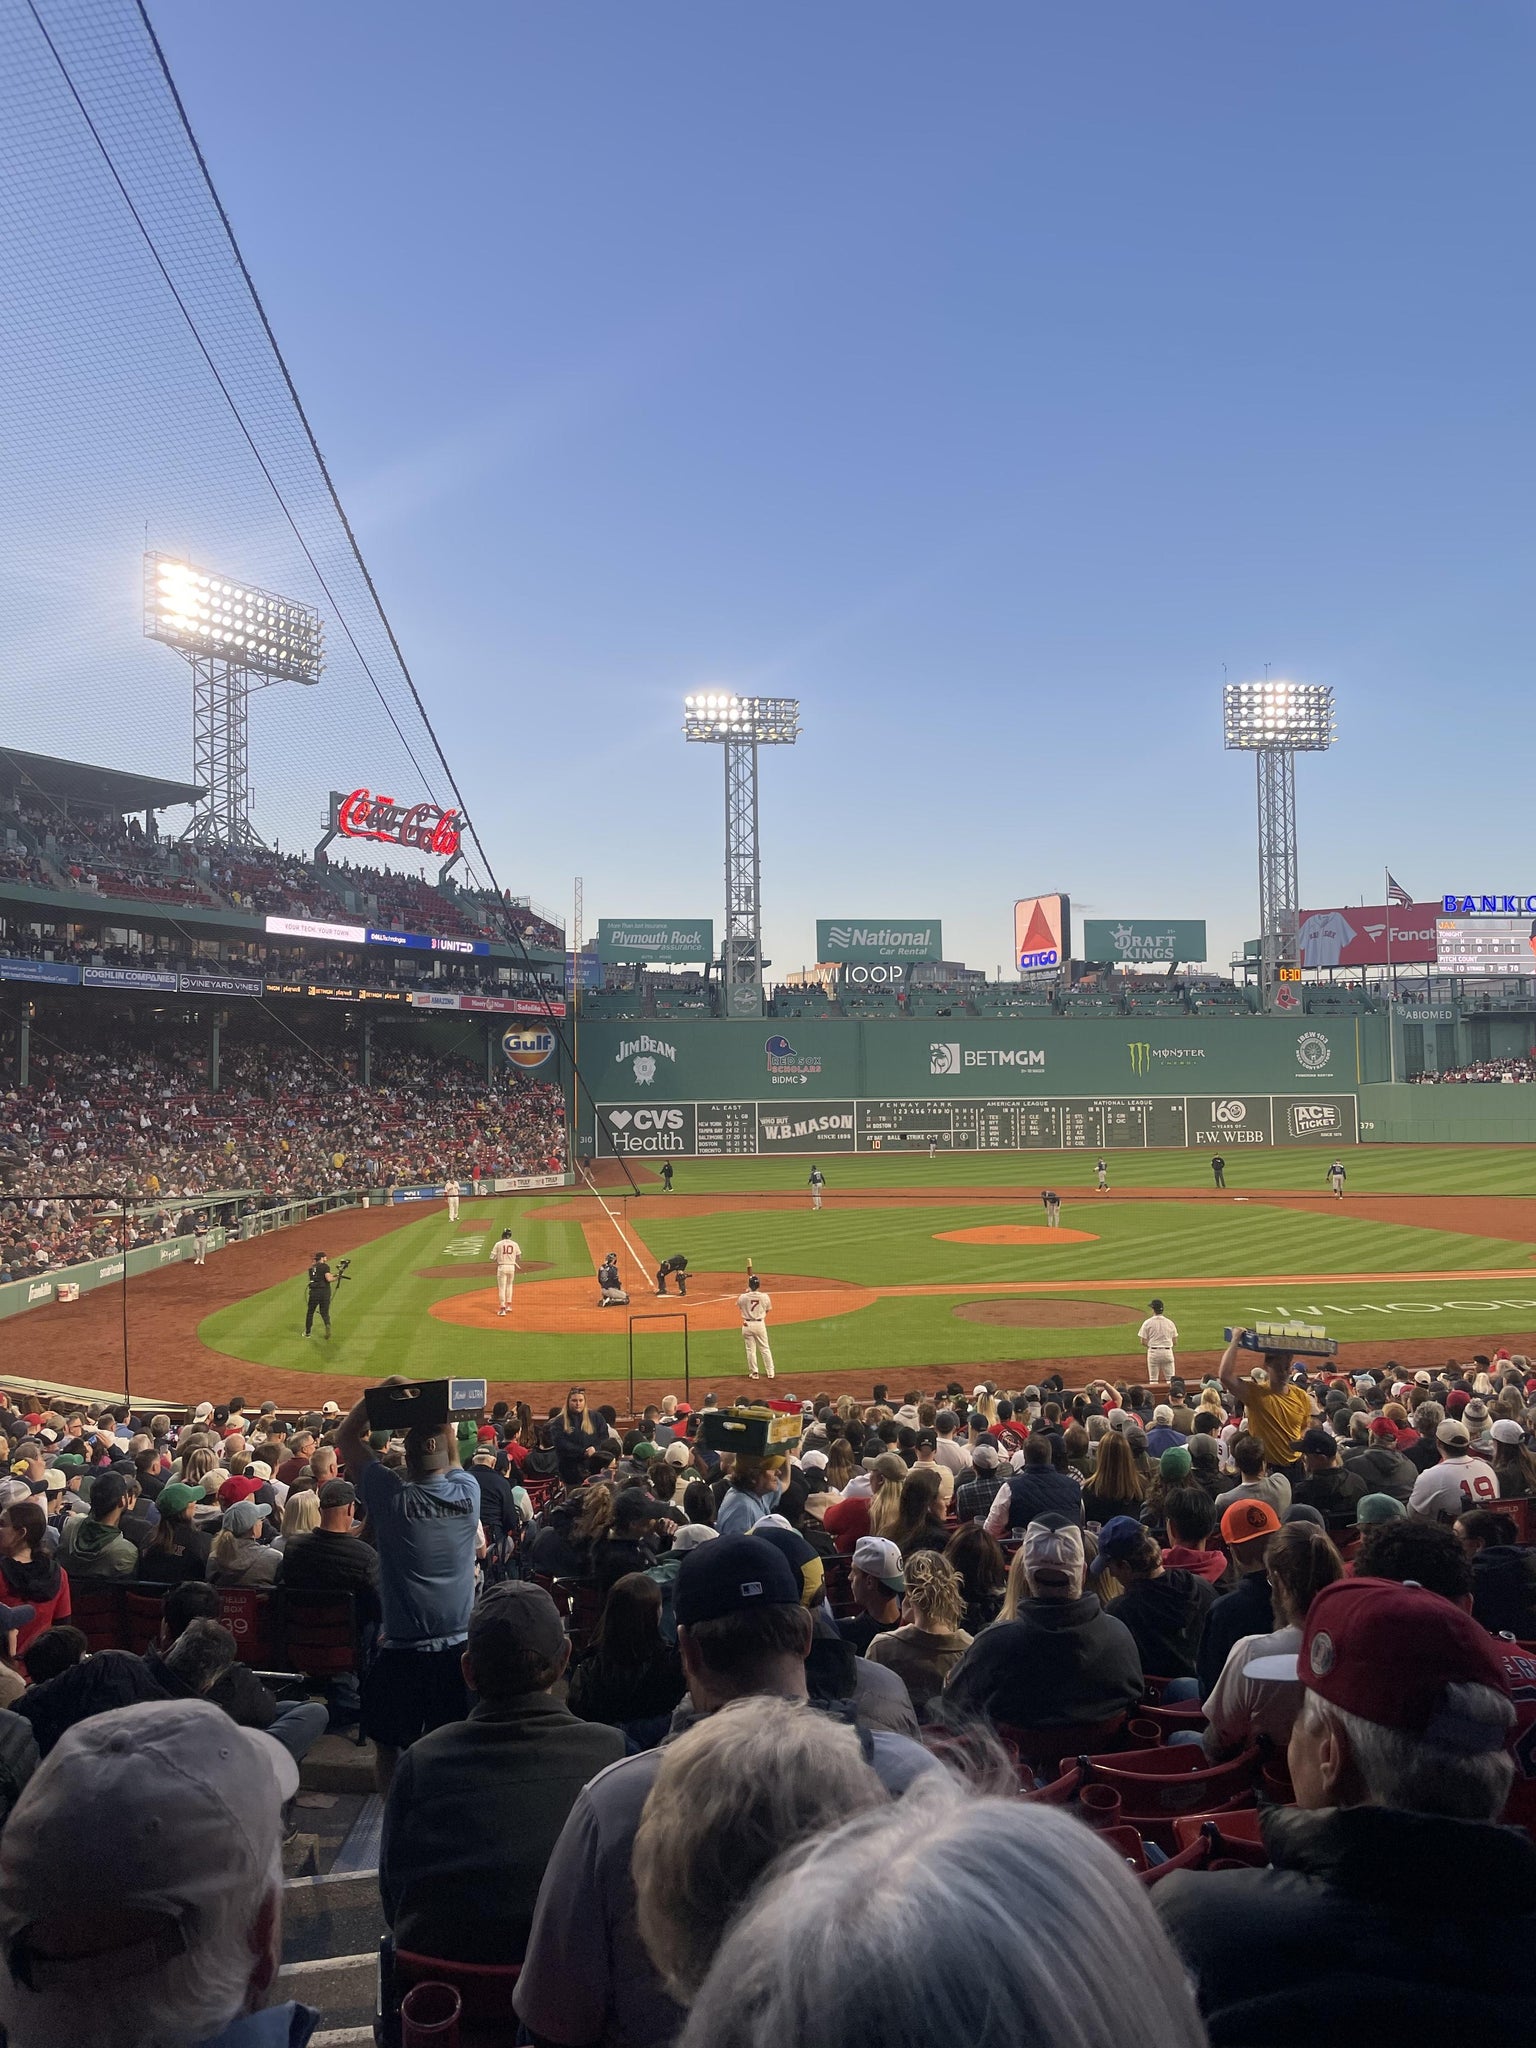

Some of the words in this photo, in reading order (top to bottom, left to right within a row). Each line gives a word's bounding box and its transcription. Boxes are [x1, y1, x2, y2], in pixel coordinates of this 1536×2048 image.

[339, 788, 460, 856] Coca-Cola
[1444, 895, 1517, 912] BANK
[611, 931, 668, 945] Plymouth
[671, 931, 701, 944] Rock
[1114, 935, 1176, 950] DRAFT
[440, 940, 474, 953] UNITED
[880, 947, 895, 956] Car
[898, 947, 928, 956] Rental
[1020, 950, 1057, 968] CITGO
[1122, 948, 1175, 959] KINGS
[85, 969, 124, 980] COGHLIN
[125, 972, 176, 983] COMPANIES
[190, 980, 234, 989] VINEYARD
[235, 983, 260, 991] VINES
[517, 1003, 541, 1012] Safelite
[1406, 1010, 1453, 1020] ABIOMED
[504, 1035, 553, 1051] Gulf
[615, 1040, 640, 1063] JIM
[640, 1034, 677, 1063] BEAM
[964, 1050, 1045, 1066] BETMGM
[1152, 1048, 1206, 1058] MONSTER
[772, 1056, 795, 1066] RED
[798, 1056, 822, 1065] SOX
[771, 1065, 822, 1073] SCHOLARS
[771, 1076, 799, 1084] BIDMC
[1211, 1100, 1247, 1123] 160
[1298, 1106, 1335, 1120] ACE
[633, 1109, 684, 1130] CVS
[794, 1115, 854, 1137] MASON
[1298, 1119, 1336, 1131] TICKET
[1359, 1122, 1374, 1130] 379
[764, 1125, 796, 1140] W.B.
[1196, 1131, 1220, 1144] F.W.
[1220, 1130, 1264, 1143] WEBB
[579, 1136, 593, 1144] 310
[612, 1131, 685, 1152] Health
[872, 1140, 881, 1149] 10
[502, 1244, 514, 1255] 10
[750, 1299, 760, 1312] 7
[1460, 1476, 1496, 1500] 19
[220, 1596, 248, 1604] IELD
[223, 1605, 244, 1613] BOX
[221, 1617, 248, 1634] 39
